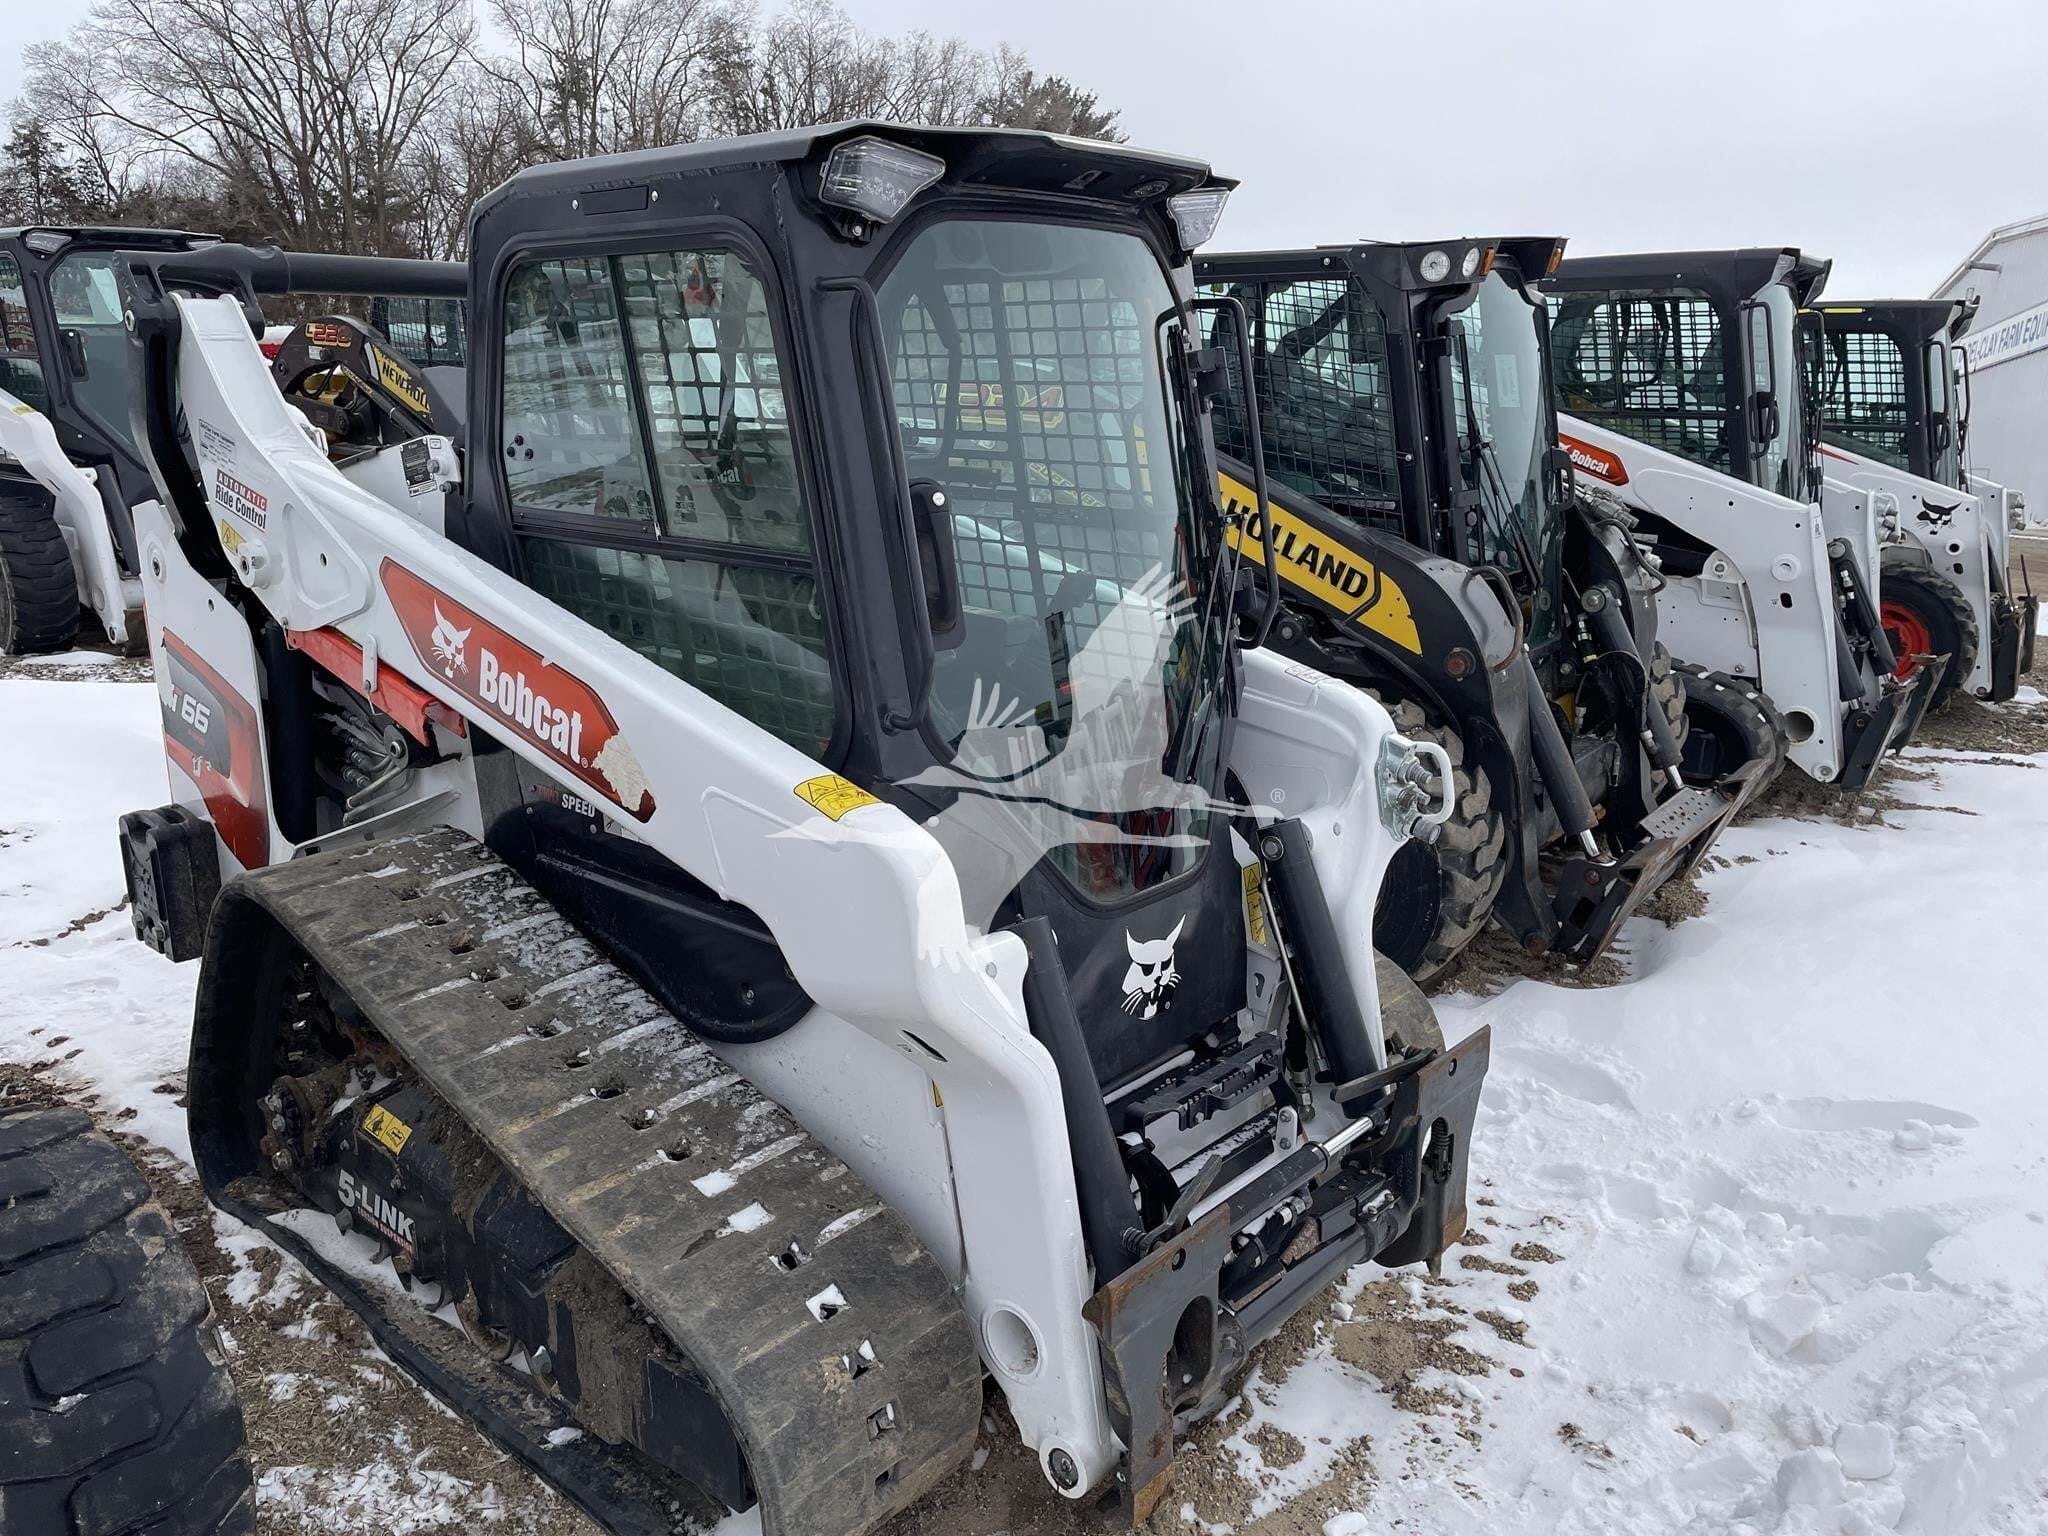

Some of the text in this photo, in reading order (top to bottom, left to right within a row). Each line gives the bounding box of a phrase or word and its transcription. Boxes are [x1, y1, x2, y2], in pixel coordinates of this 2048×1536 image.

[1999, 320, 2024, 353] FARM
[1569, 448, 1609, 475] Bobcat
[215, 484, 267, 529] Ride Control
[217, 472, 266, 510] AUTOMATIC
[1226, 497, 1368, 599] HOLLAND
[479, 647, 583, 765] Bobcat
[561, 793, 596, 818] SPEED
[337, 1168, 415, 1243] 5-LINK
